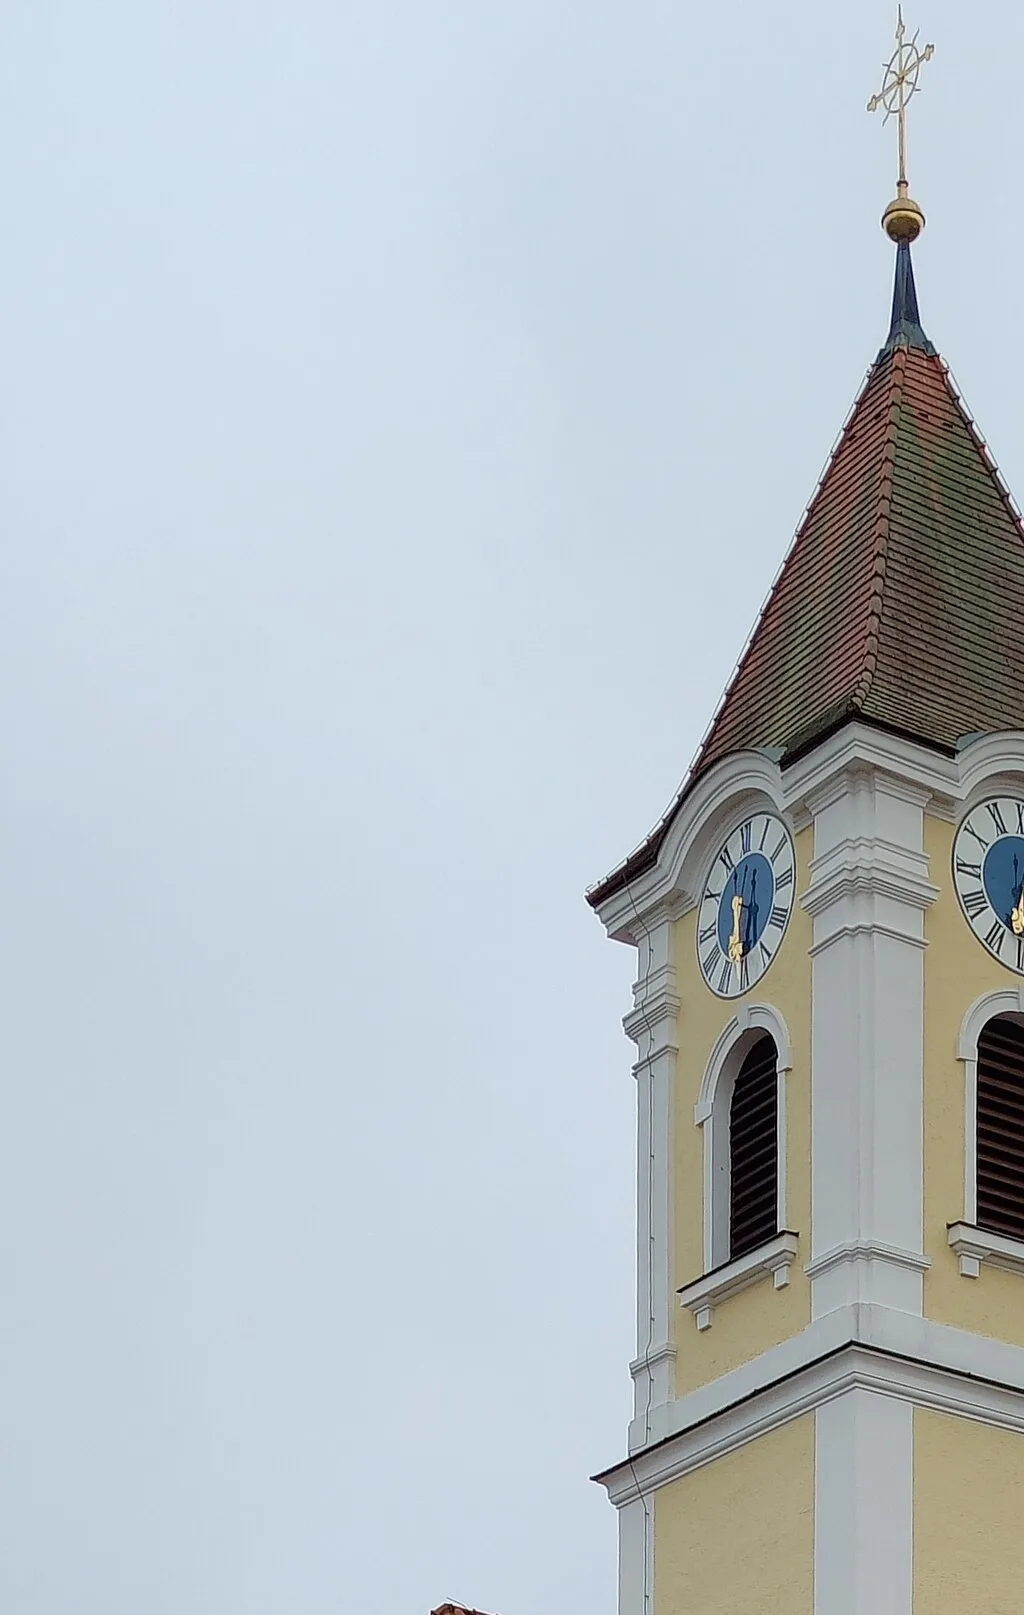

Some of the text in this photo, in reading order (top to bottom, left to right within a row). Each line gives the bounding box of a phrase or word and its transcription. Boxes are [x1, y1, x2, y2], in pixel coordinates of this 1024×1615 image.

[985, 802, 1008, 837] XI
[963, 820, 990, 853] X
[956, 855, 982, 880] IX
[961, 890, 990, 922] VIII
[983, 918, 1007, 955] VII
